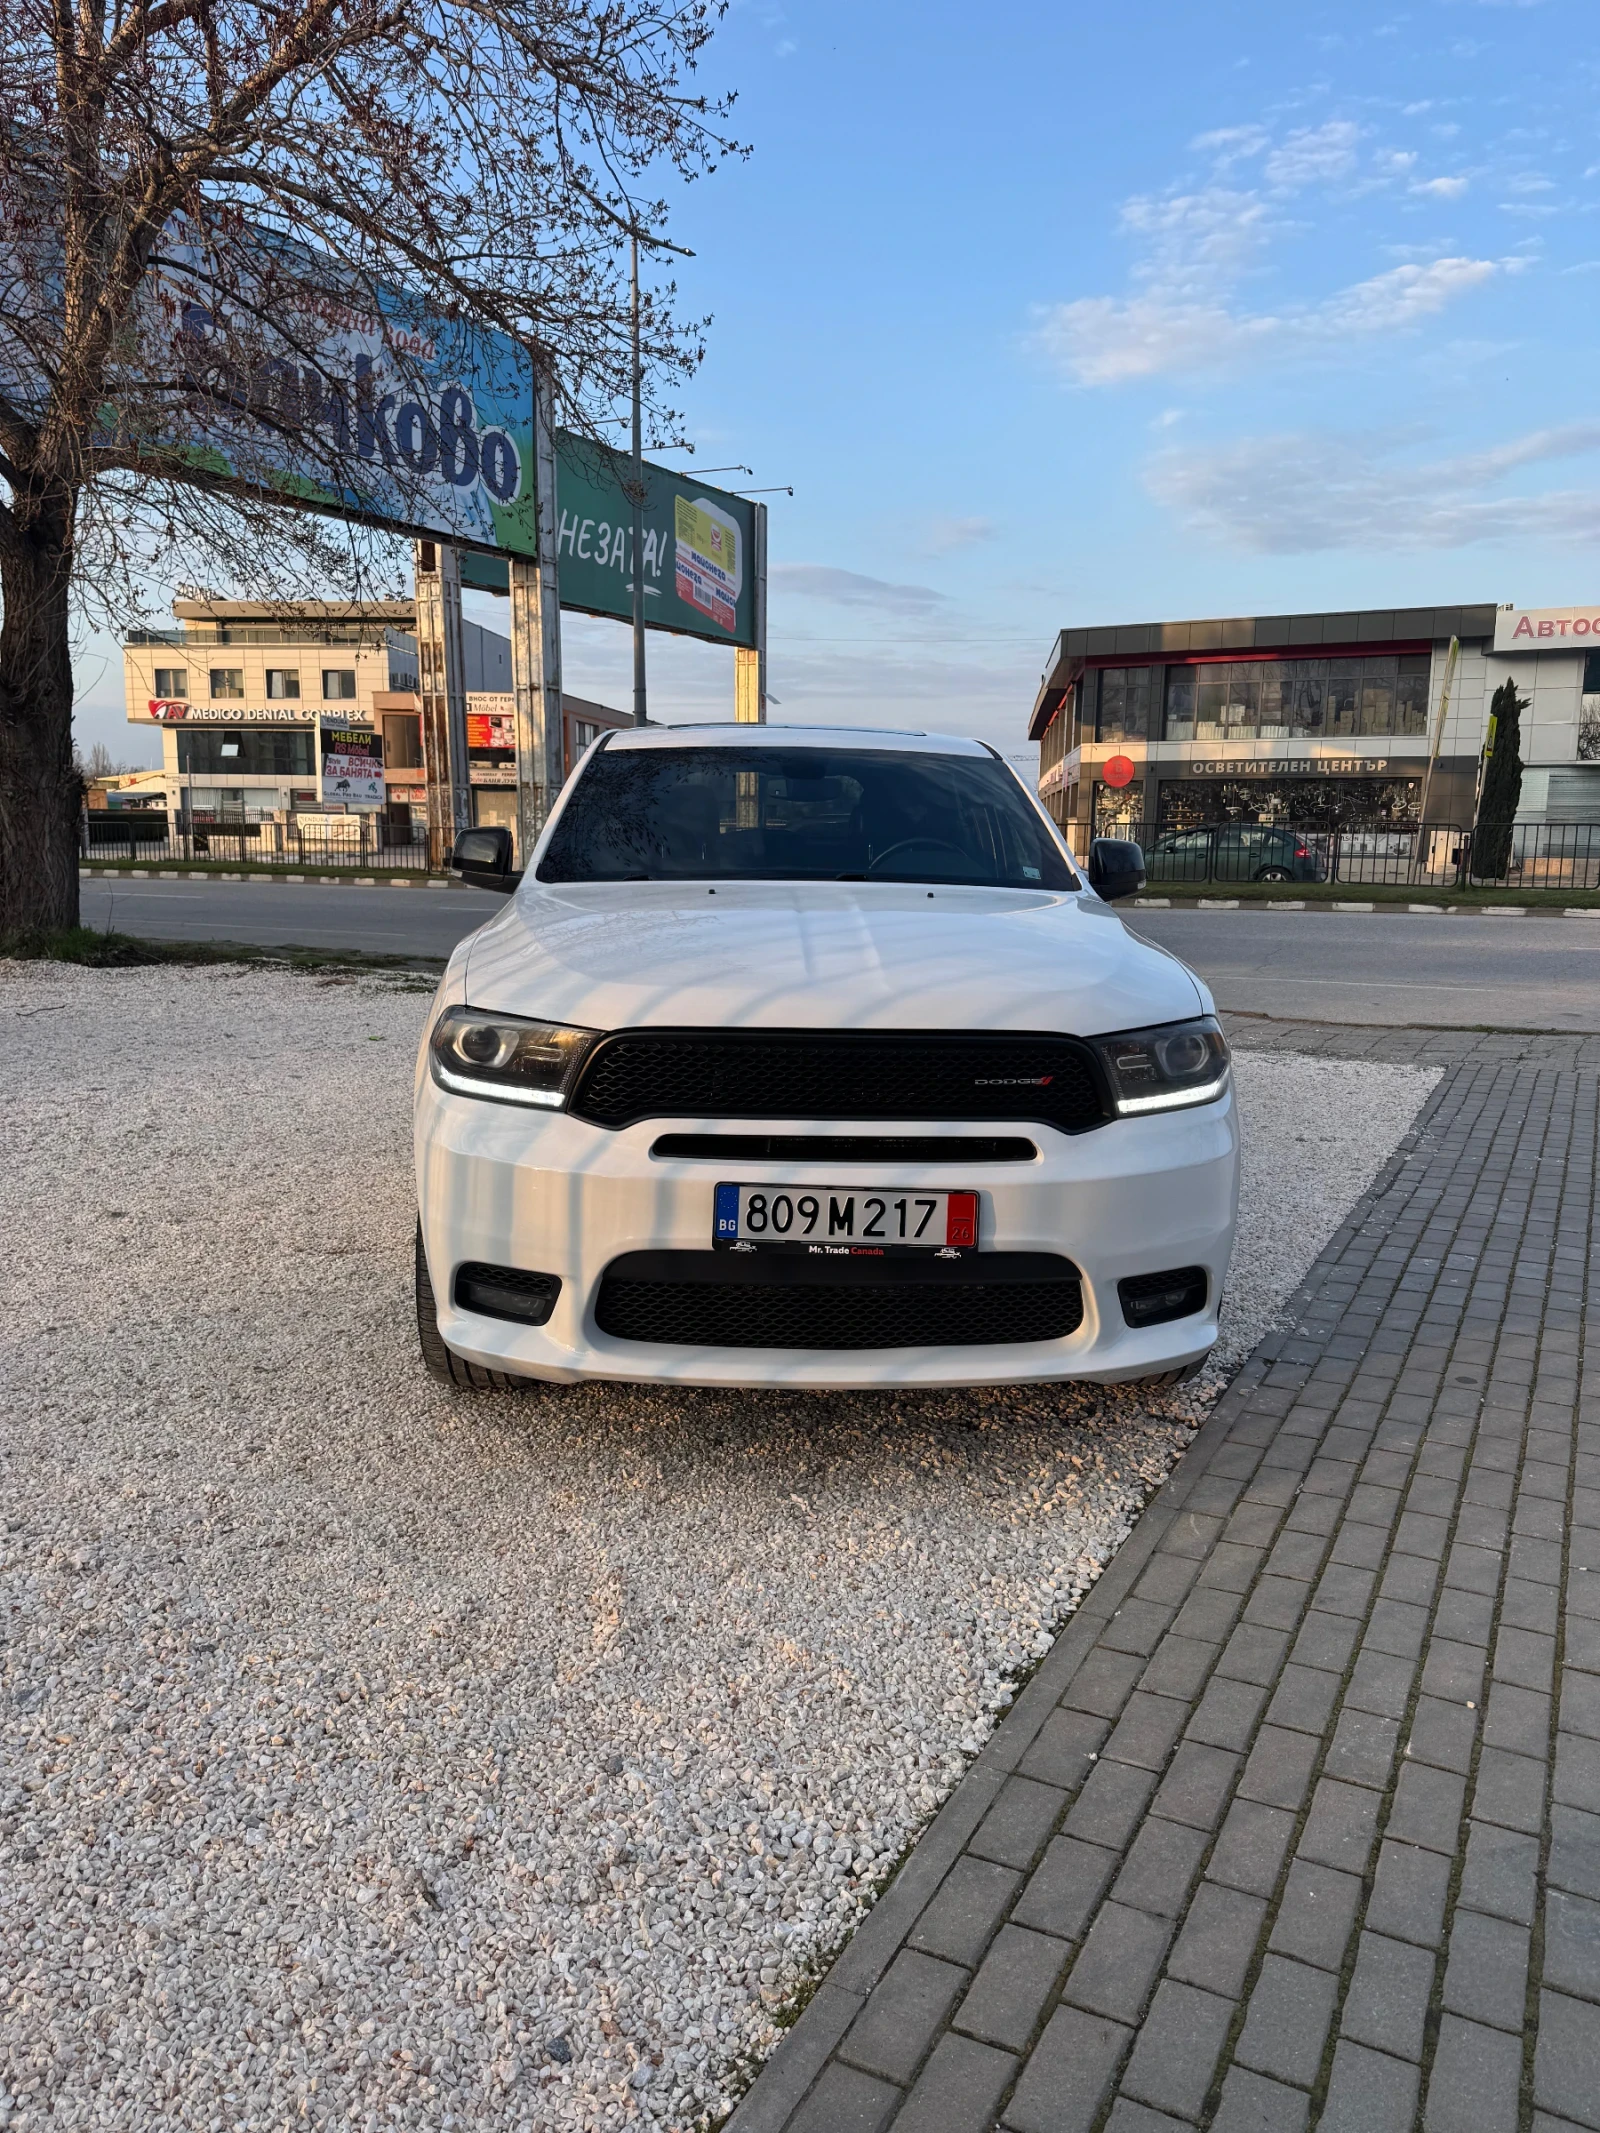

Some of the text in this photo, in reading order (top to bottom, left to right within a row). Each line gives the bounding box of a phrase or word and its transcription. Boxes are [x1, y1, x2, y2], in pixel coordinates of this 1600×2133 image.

[191, 709, 242, 720] MEDICO
[247, 709, 295, 720] DENTAL
[301, 709, 364, 721] COMPLEX
[331, 731, 371, 745] МЕБЕЛИ
[335, 742, 347, 754] RS
[326, 765, 373, 779] ЗА БАНЯТА
[1192, 759, 1388, 775] ОСВЕТИТЕЛЕН ЦЕНТЪР
[718, 1218, 736, 1231] BG
[808, 1245, 884, 1256] Mr. Trade Canada
